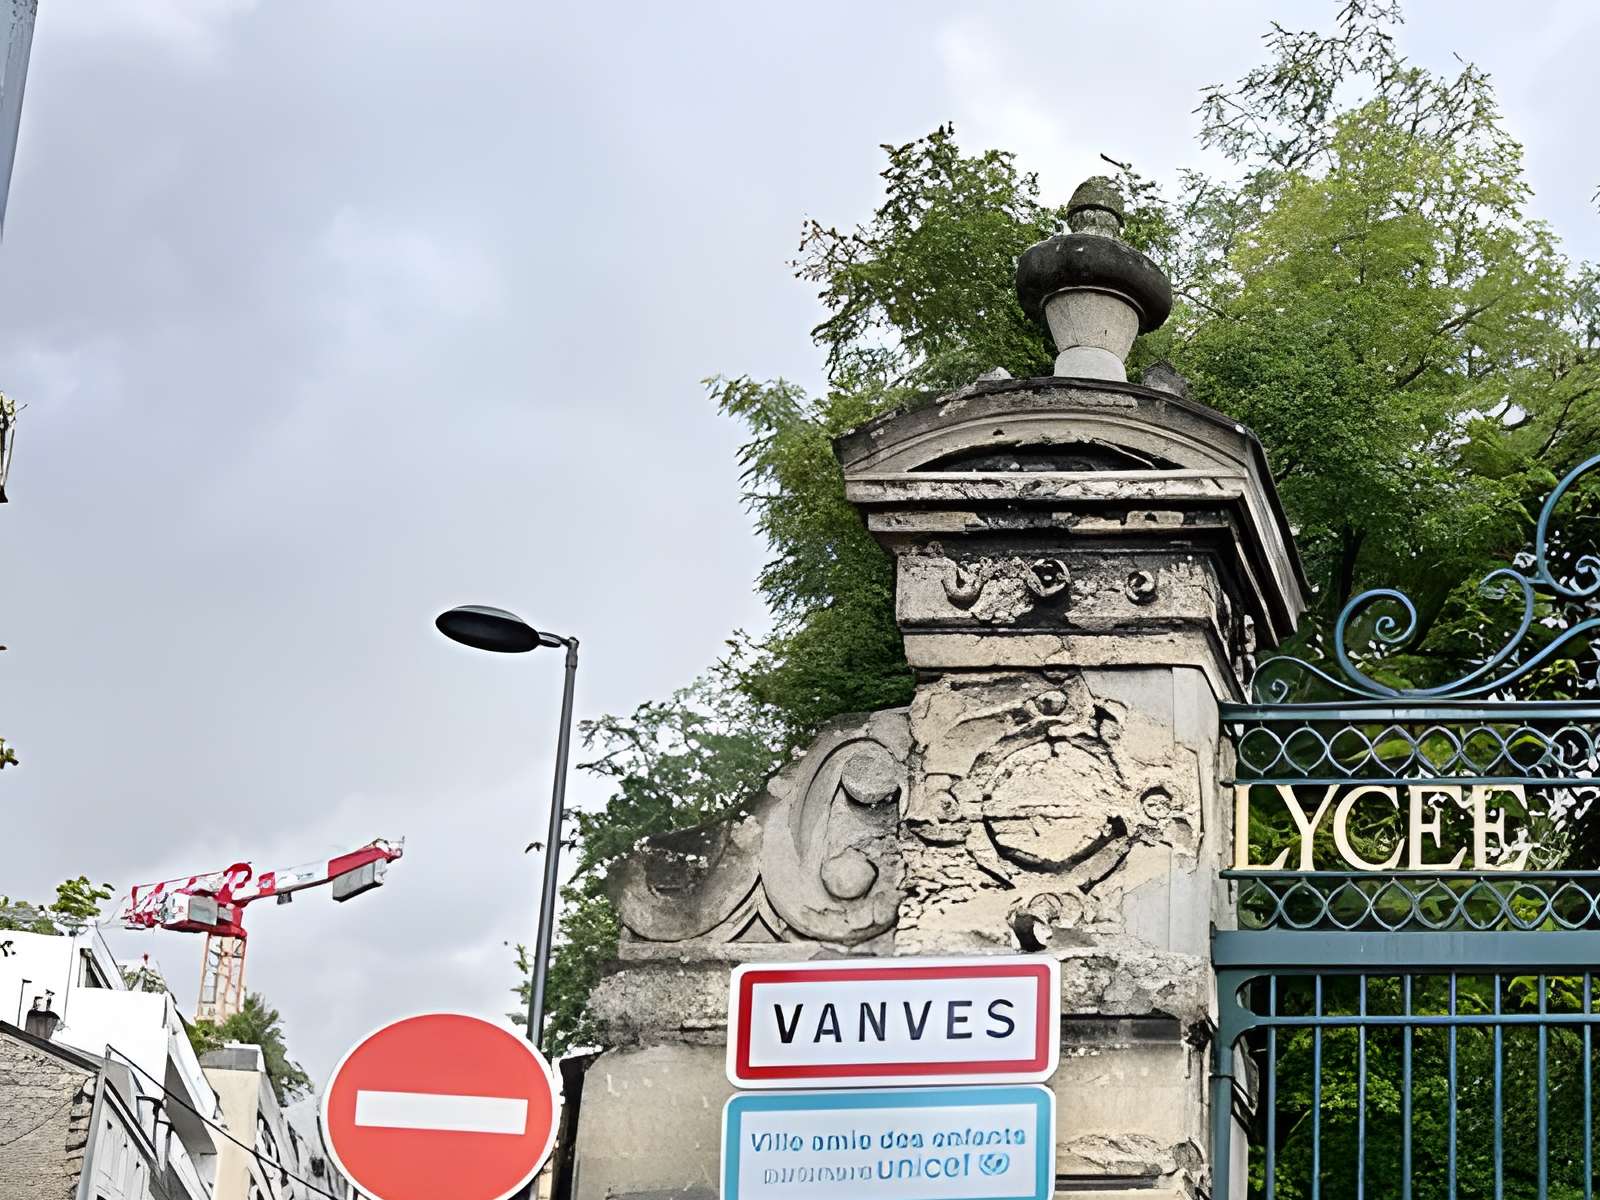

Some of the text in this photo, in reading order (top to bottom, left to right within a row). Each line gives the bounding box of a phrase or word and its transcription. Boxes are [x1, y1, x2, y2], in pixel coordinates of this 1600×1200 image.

[774, 999, 1016, 1044] VANVES
[751, 1132, 803, 1152] Ville
[878, 1153, 970, 1180] unicef
